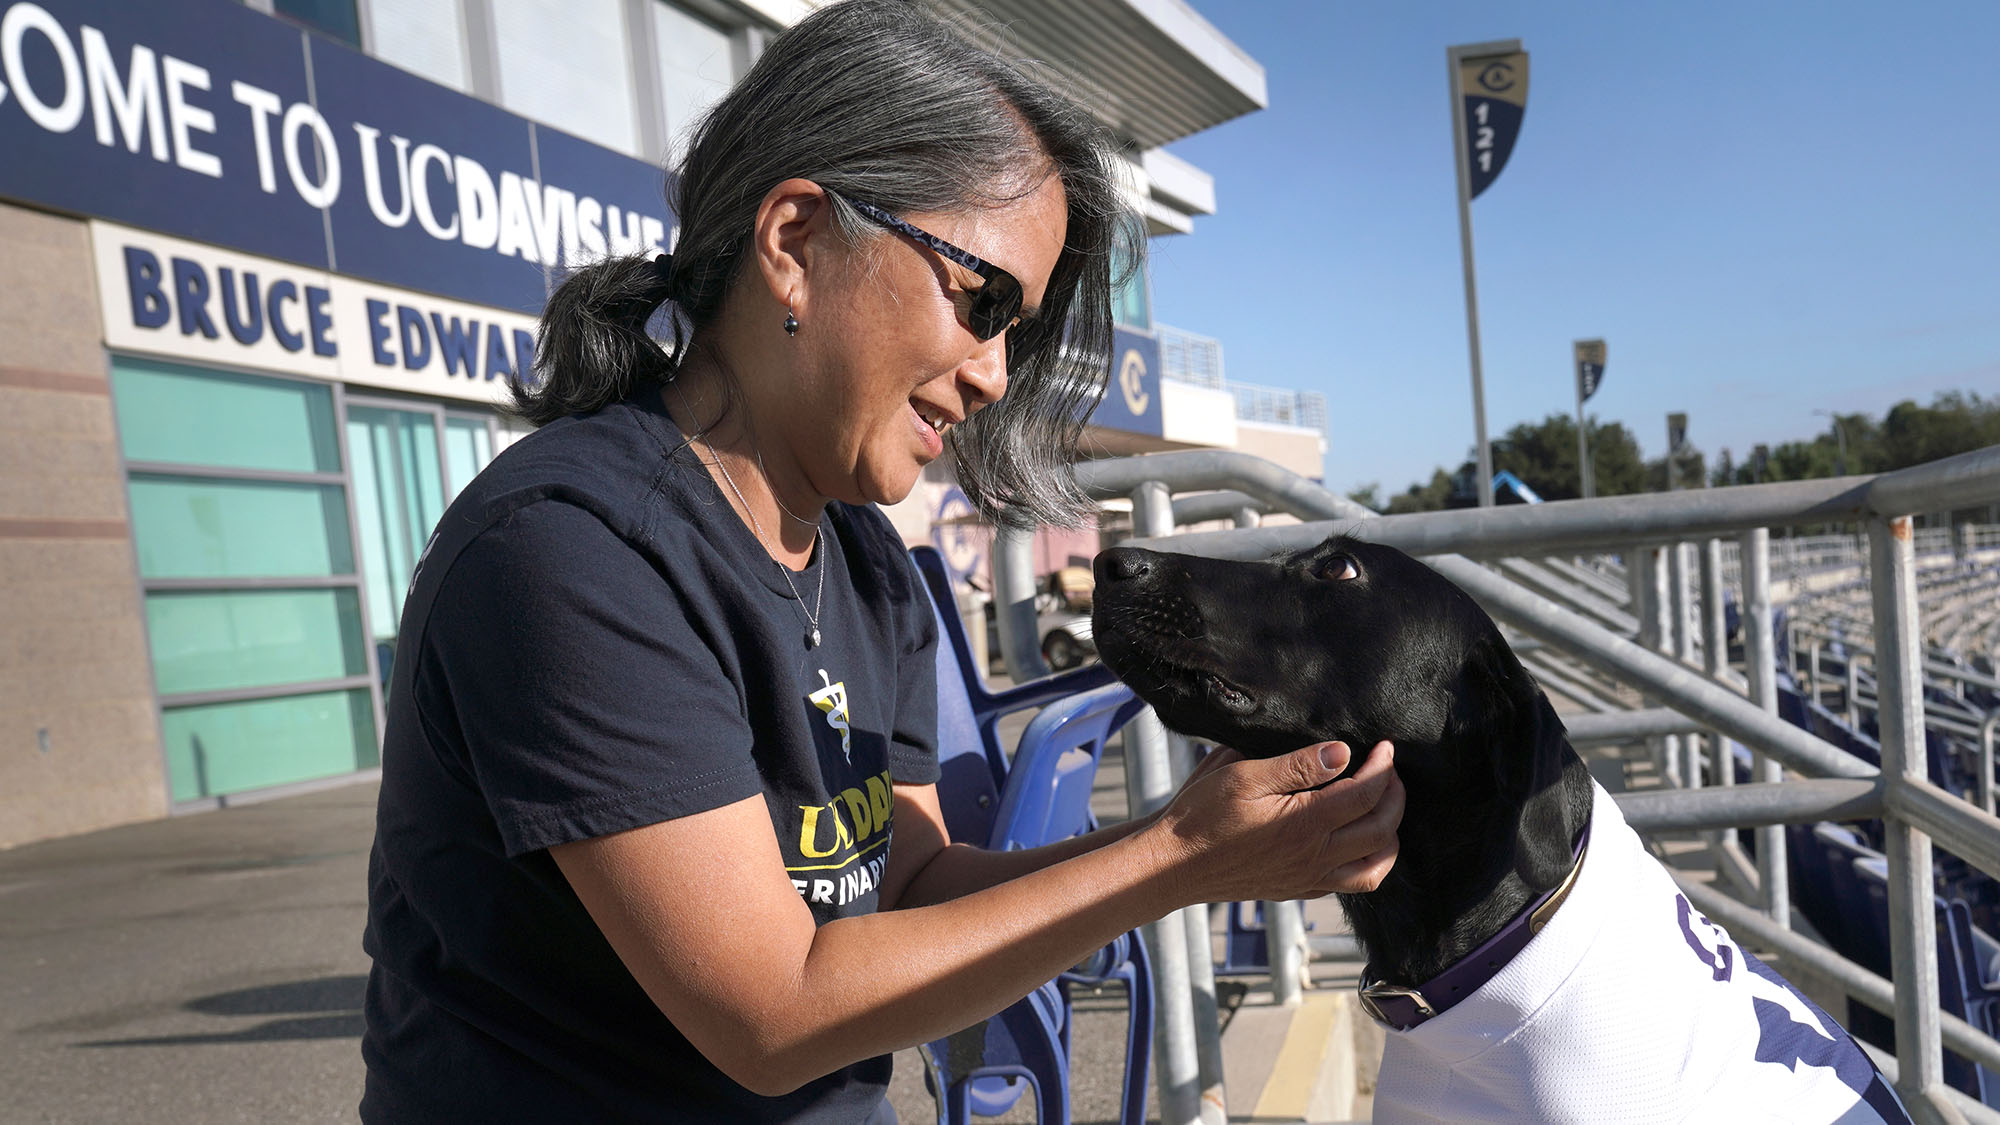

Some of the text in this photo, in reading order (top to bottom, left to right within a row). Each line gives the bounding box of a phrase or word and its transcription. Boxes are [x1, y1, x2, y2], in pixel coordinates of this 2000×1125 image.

[0, 2, 223, 178] OME
[231, 79, 341, 209] TO
[1474, 102, 1495, 172] 121
[121, 245, 338, 359] BRUCE
